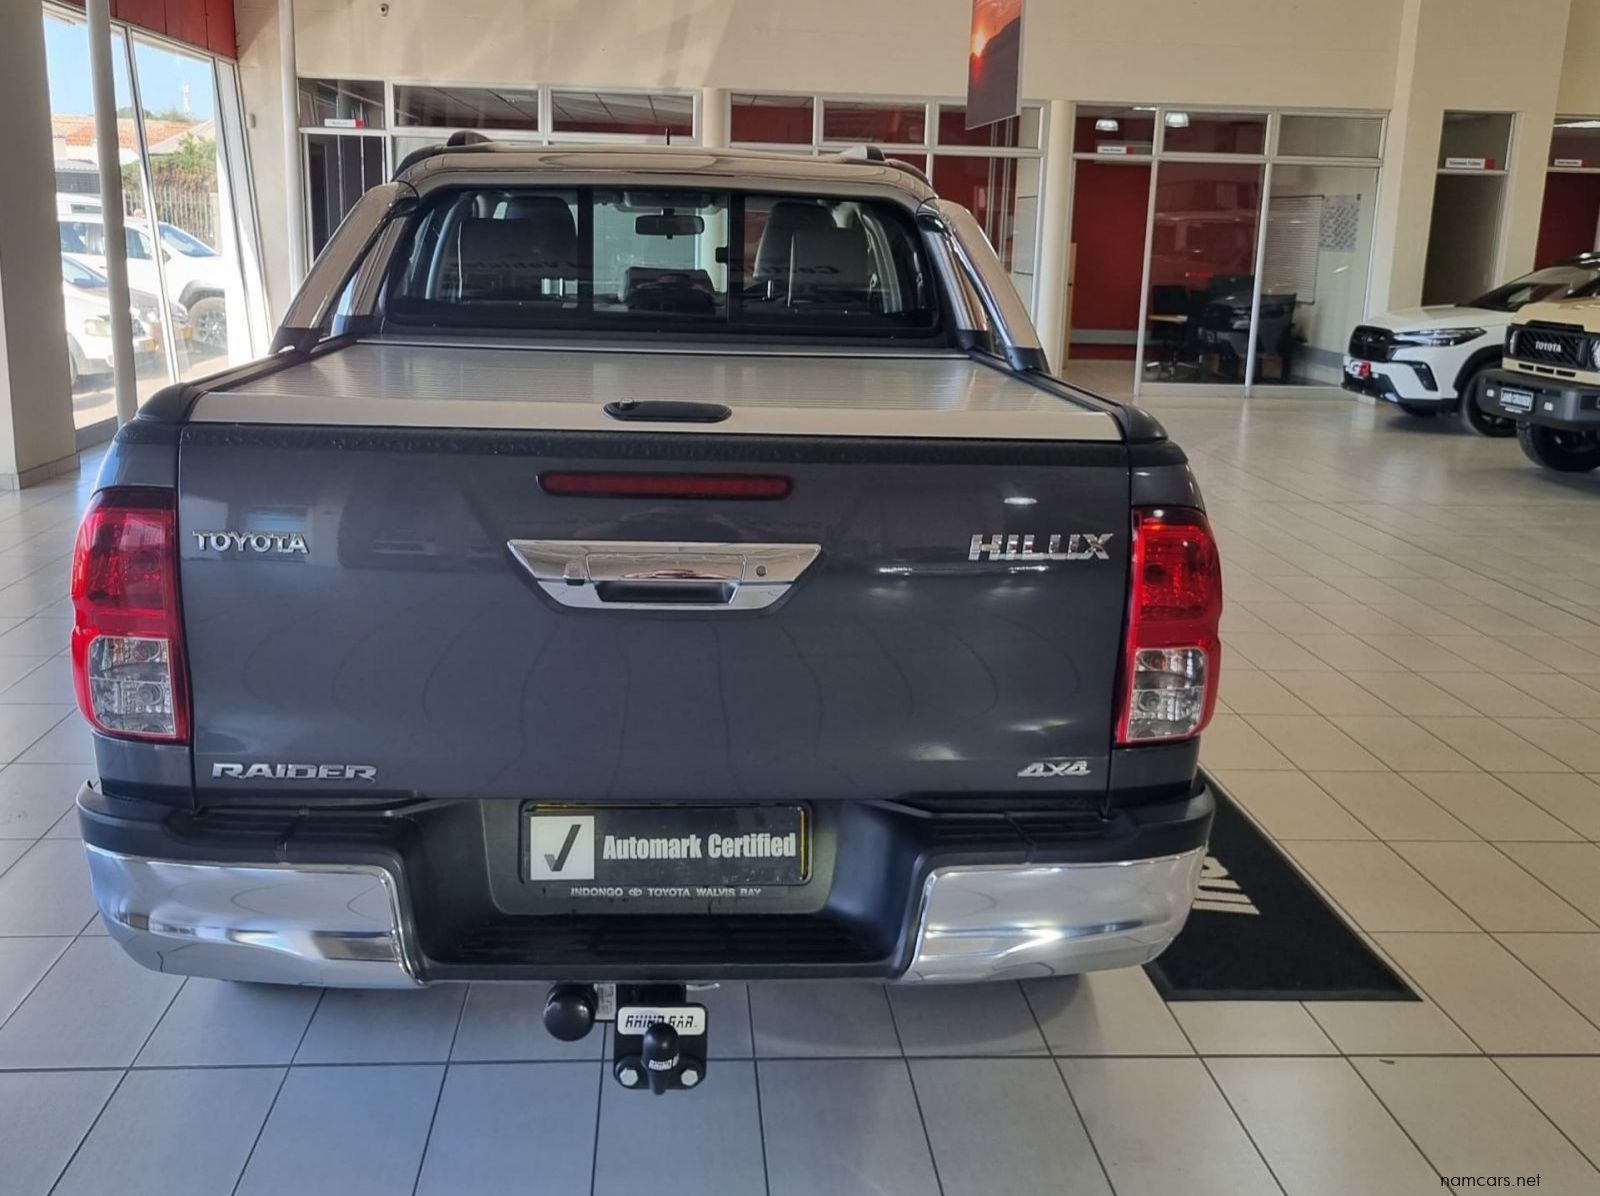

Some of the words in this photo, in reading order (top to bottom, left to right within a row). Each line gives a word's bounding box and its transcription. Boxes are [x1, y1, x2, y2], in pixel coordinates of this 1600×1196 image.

[1535, 341, 1562, 352] TOYOTA
[192, 530, 310, 554] TOYOTA
[968, 533, 1114, 561] HILUX
[211, 762, 378, 783] RAIDER
[602, 834, 702, 860] Automark
[707, 833, 797, 858] Certified
[570, 887, 624, 897] INDONGO
[647, 887, 691, 897] TOYOTA
[696, 887, 736, 897] WALVIS
[740, 887, 762, 897] BAY
